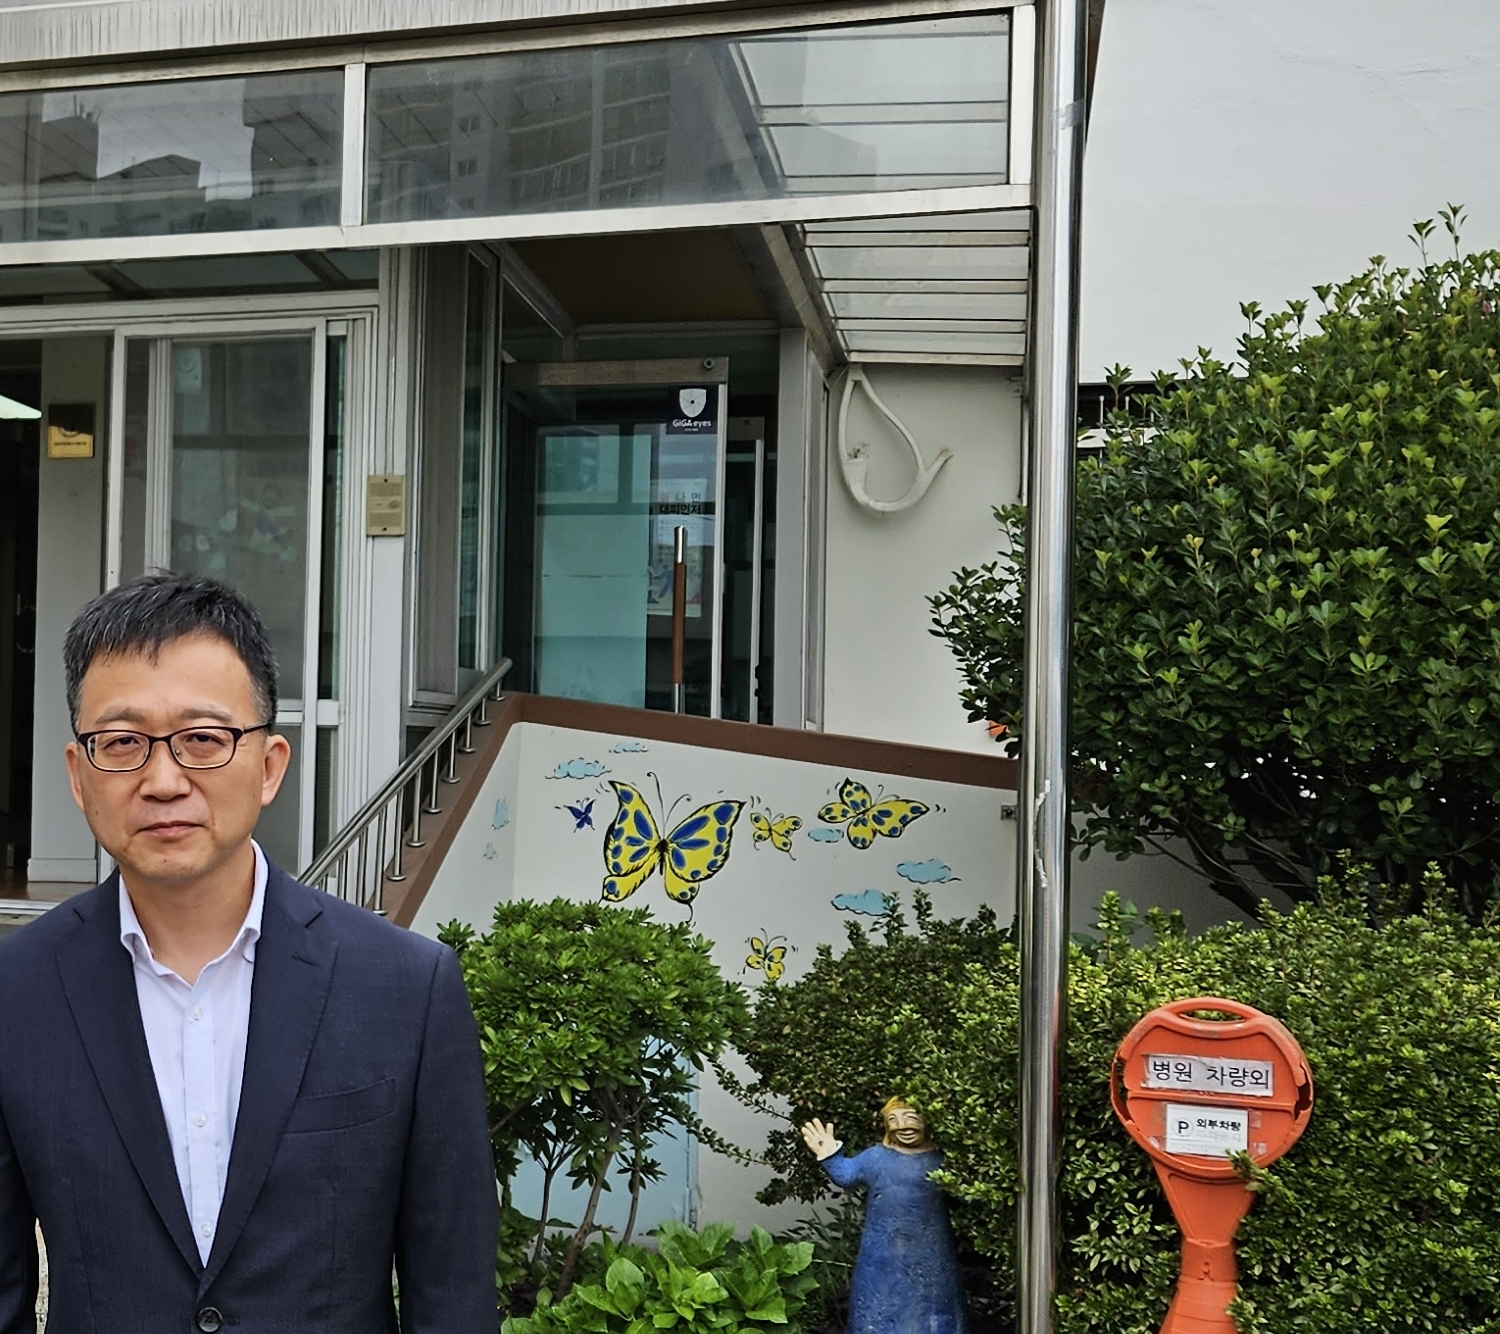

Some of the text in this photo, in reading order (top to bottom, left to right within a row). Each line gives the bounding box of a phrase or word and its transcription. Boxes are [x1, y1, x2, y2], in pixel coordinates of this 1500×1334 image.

[1153, 1060, 1269, 1089] 병원 차량외
[1196, 1118, 1242, 1132] 외부차량
